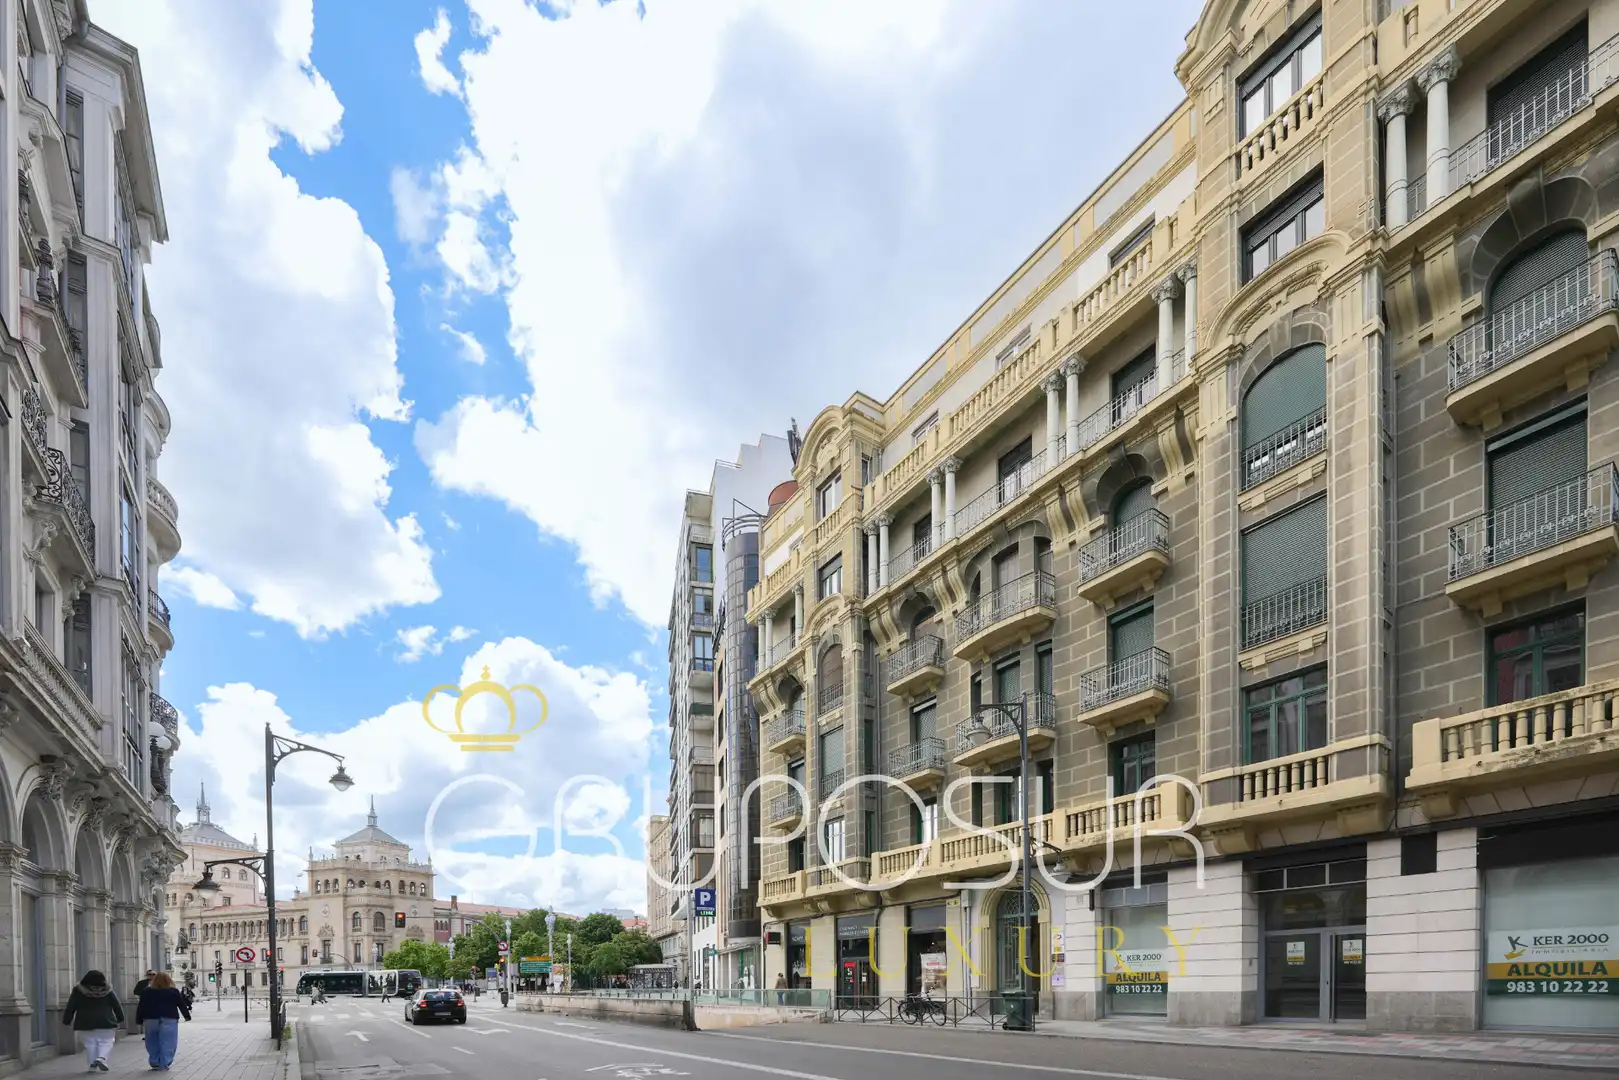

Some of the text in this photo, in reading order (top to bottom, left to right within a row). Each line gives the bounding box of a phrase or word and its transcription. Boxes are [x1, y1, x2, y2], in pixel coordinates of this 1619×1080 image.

[700, 892, 711, 906] P
[1532, 933, 1609, 946] KER 2000
[1507, 961, 1609, 977] ALQUILA
[1116, 972, 1162, 982] ALQUILA
[1116, 986, 1130, 994] 983
[1506, 980, 1609, 993] 983 10 22 22
